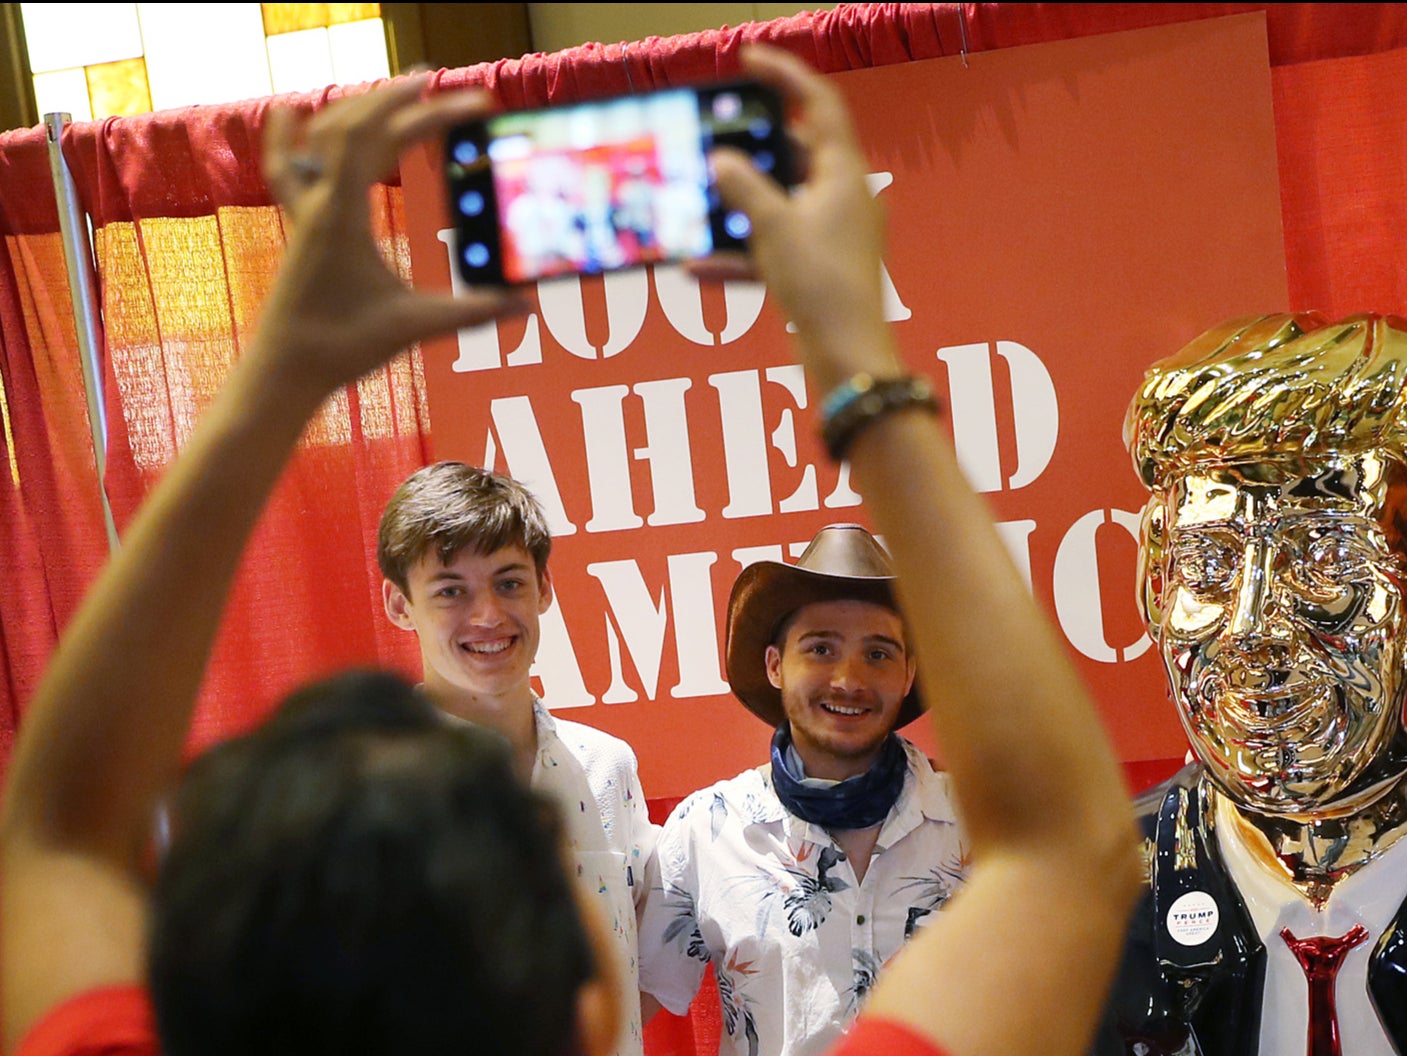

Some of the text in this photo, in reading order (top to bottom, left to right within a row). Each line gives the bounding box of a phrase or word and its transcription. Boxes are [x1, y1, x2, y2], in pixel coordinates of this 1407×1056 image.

[437, 171, 913, 373] LOO
[484, 340, 1060, 537] AHED
[1173, 911, 1214, 921] TRUMP
